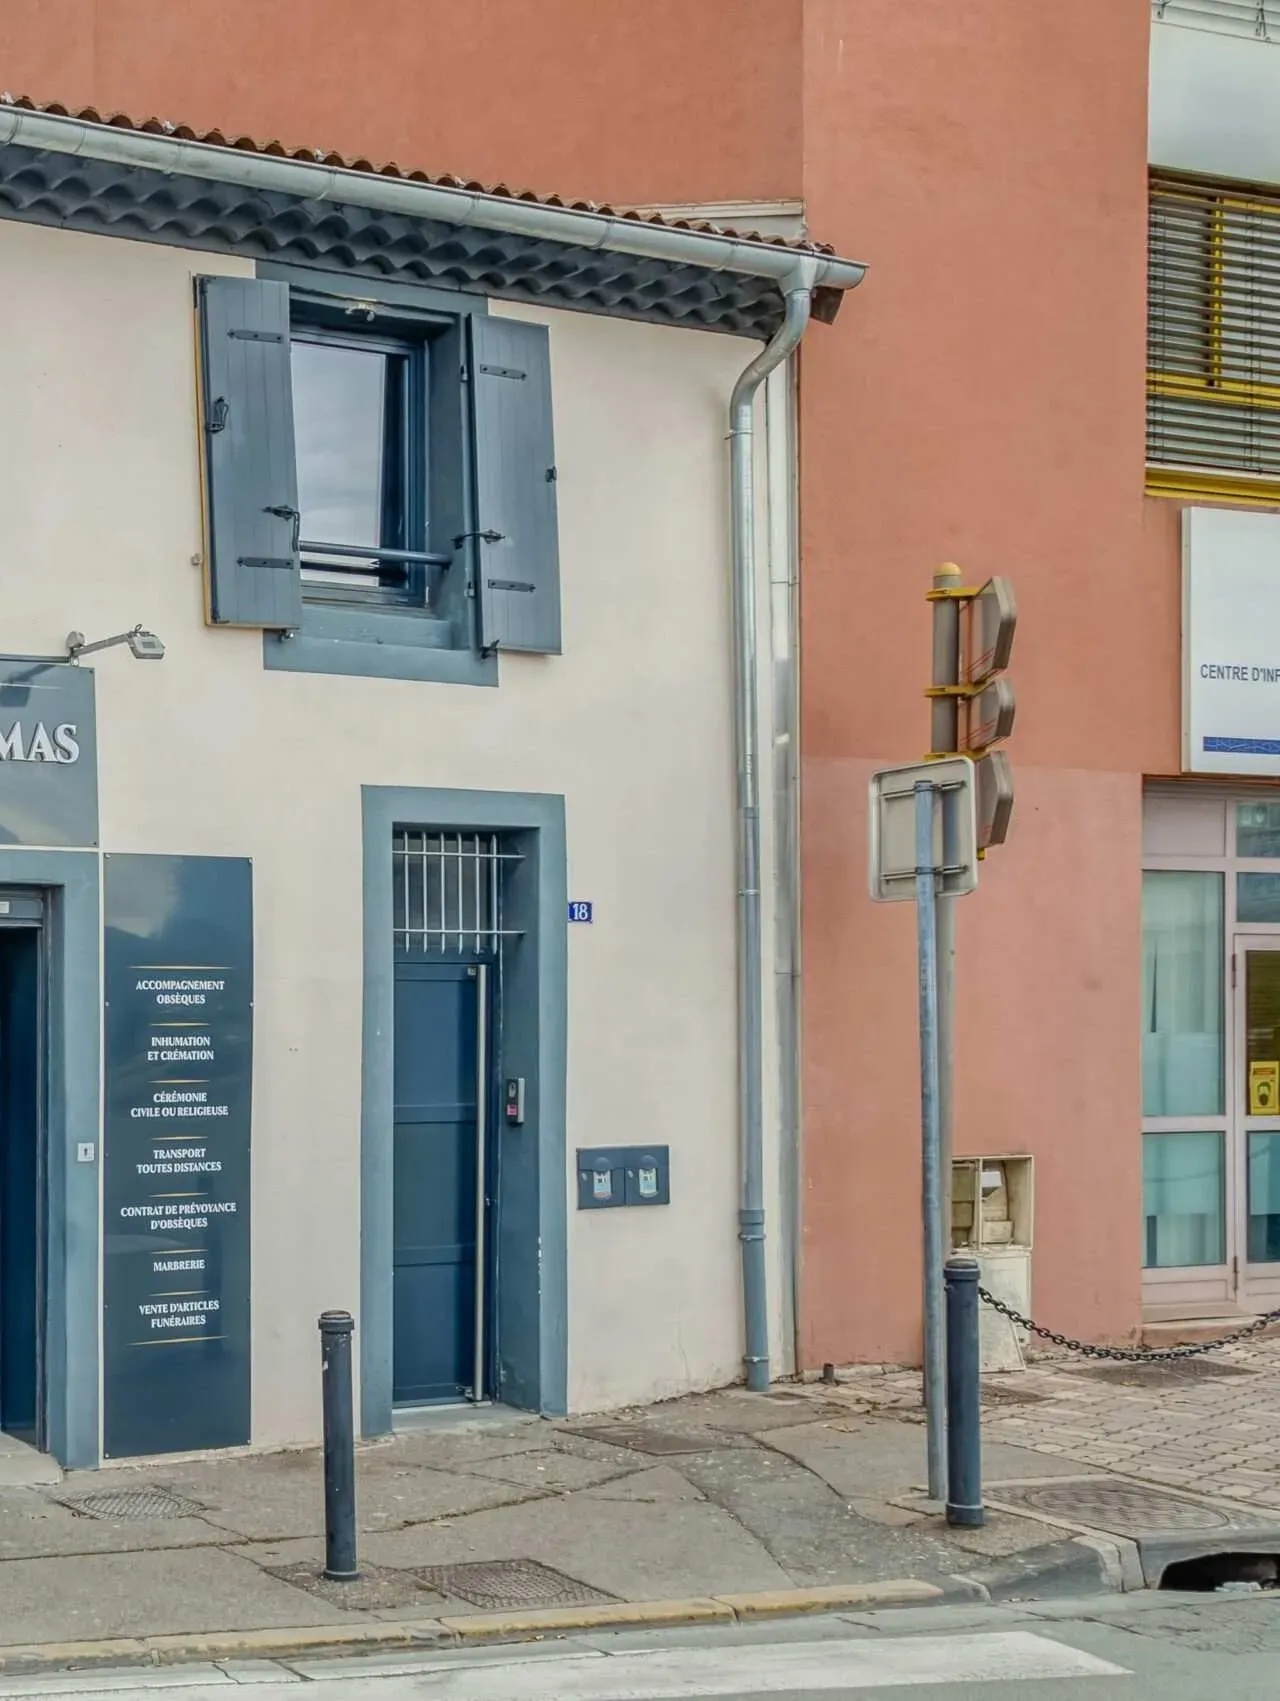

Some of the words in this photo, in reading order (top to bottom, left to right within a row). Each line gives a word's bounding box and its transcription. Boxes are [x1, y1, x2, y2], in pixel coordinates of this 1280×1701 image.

[1200, 664, 1249, 681] CENTRE
[573, 903, 589, 920] 18
[136, 980, 225, 991] ACCOMPAGNEMENT
[156, 992, 206, 1006] OBSÈQUES
[151, 1036, 211, 1047] INHUMATION
[147, 1051, 160, 1061] ET
[160, 1048, 214, 1060] CRÉMATION
[153, 1090, 208, 1103] CÉRÉMONIE
[131, 1107, 160, 1118] CIVILE
[161, 1107, 177, 1116] OU
[177, 1105, 229, 1117] RELIGIEUSE
[153, 1148, 206, 1160] TRANSPORT
[136, 1163, 173, 1174] TOUTES
[174, 1161, 222, 1173] DISTANCES
[120, 1206, 164, 1217] CONTRAT
[165, 1205, 178, 1215] DE
[179, 1202, 237, 1214] PRÉVOYANCE
[151, 1217, 208, 1230] D'OBSÈQUES
[153, 1260, 205, 1272] MARBRERIE
[139, 1303, 168, 1315] VENTE
[170, 1300, 220, 1313] D'ARTICLES
[151, 1315, 206, 1328] FUNÉRAIRES
